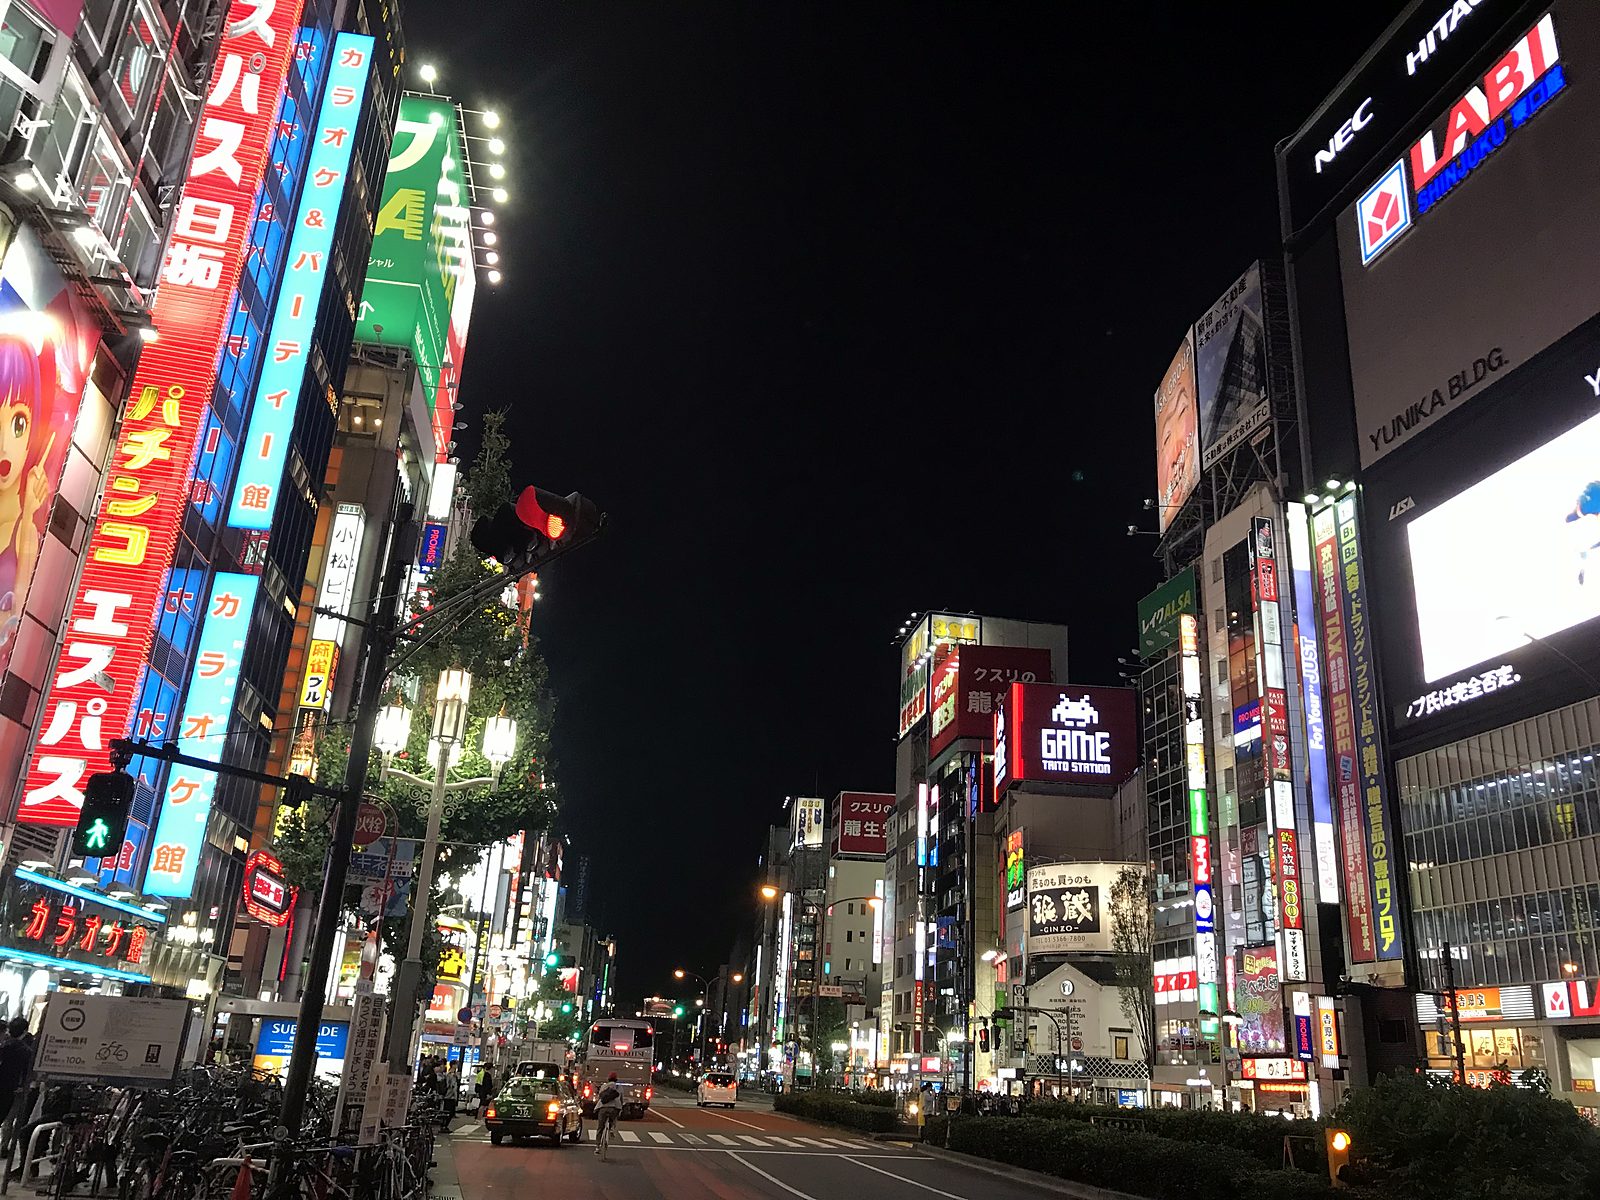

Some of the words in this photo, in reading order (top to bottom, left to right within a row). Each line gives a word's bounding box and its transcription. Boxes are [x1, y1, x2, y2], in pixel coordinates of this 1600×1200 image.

[1405, 0, 1485, 76] HITA
[1409, 12, 1560, 191] LABI
[1313, 96, 1375, 174] NEC
[1417, 117, 1507, 214] SHINJUKU
[1368, 388, 1447, 452] YUNIKA
[1447, 347, 1510, 400] BLDG.
[93, 384, 186, 566] パチンコ
[426, 529, 440, 564] PROMISE
[1325, 613, 1344, 659] TAX
[973, 666, 1037, 683] クスリの
[23, 588, 134, 810] エスパス
[1307, 693, 1322, 721] Your
[151, 592, 241, 877] カラオケ館
[1041, 728, 1111, 763] GAME
[1309, 722, 1324, 750] For
[1332, 692, 1352, 754] FREE
[1042, 760, 1069, 772] TAITO
[1071, 761, 1111, 775] STATION
[849, 802, 894, 814] クスリの
[1280, 831, 1296, 877] 飲み放題
[1032, 874, 1092, 890] 売るのも買うのも
[25, 896, 149, 965] カラオケ館
[1457, 992, 1486, 1008] 吉野家
[1299, 1017, 1309, 1051] PROMISE
[1322, 1013, 1335, 1051] 吉野家
